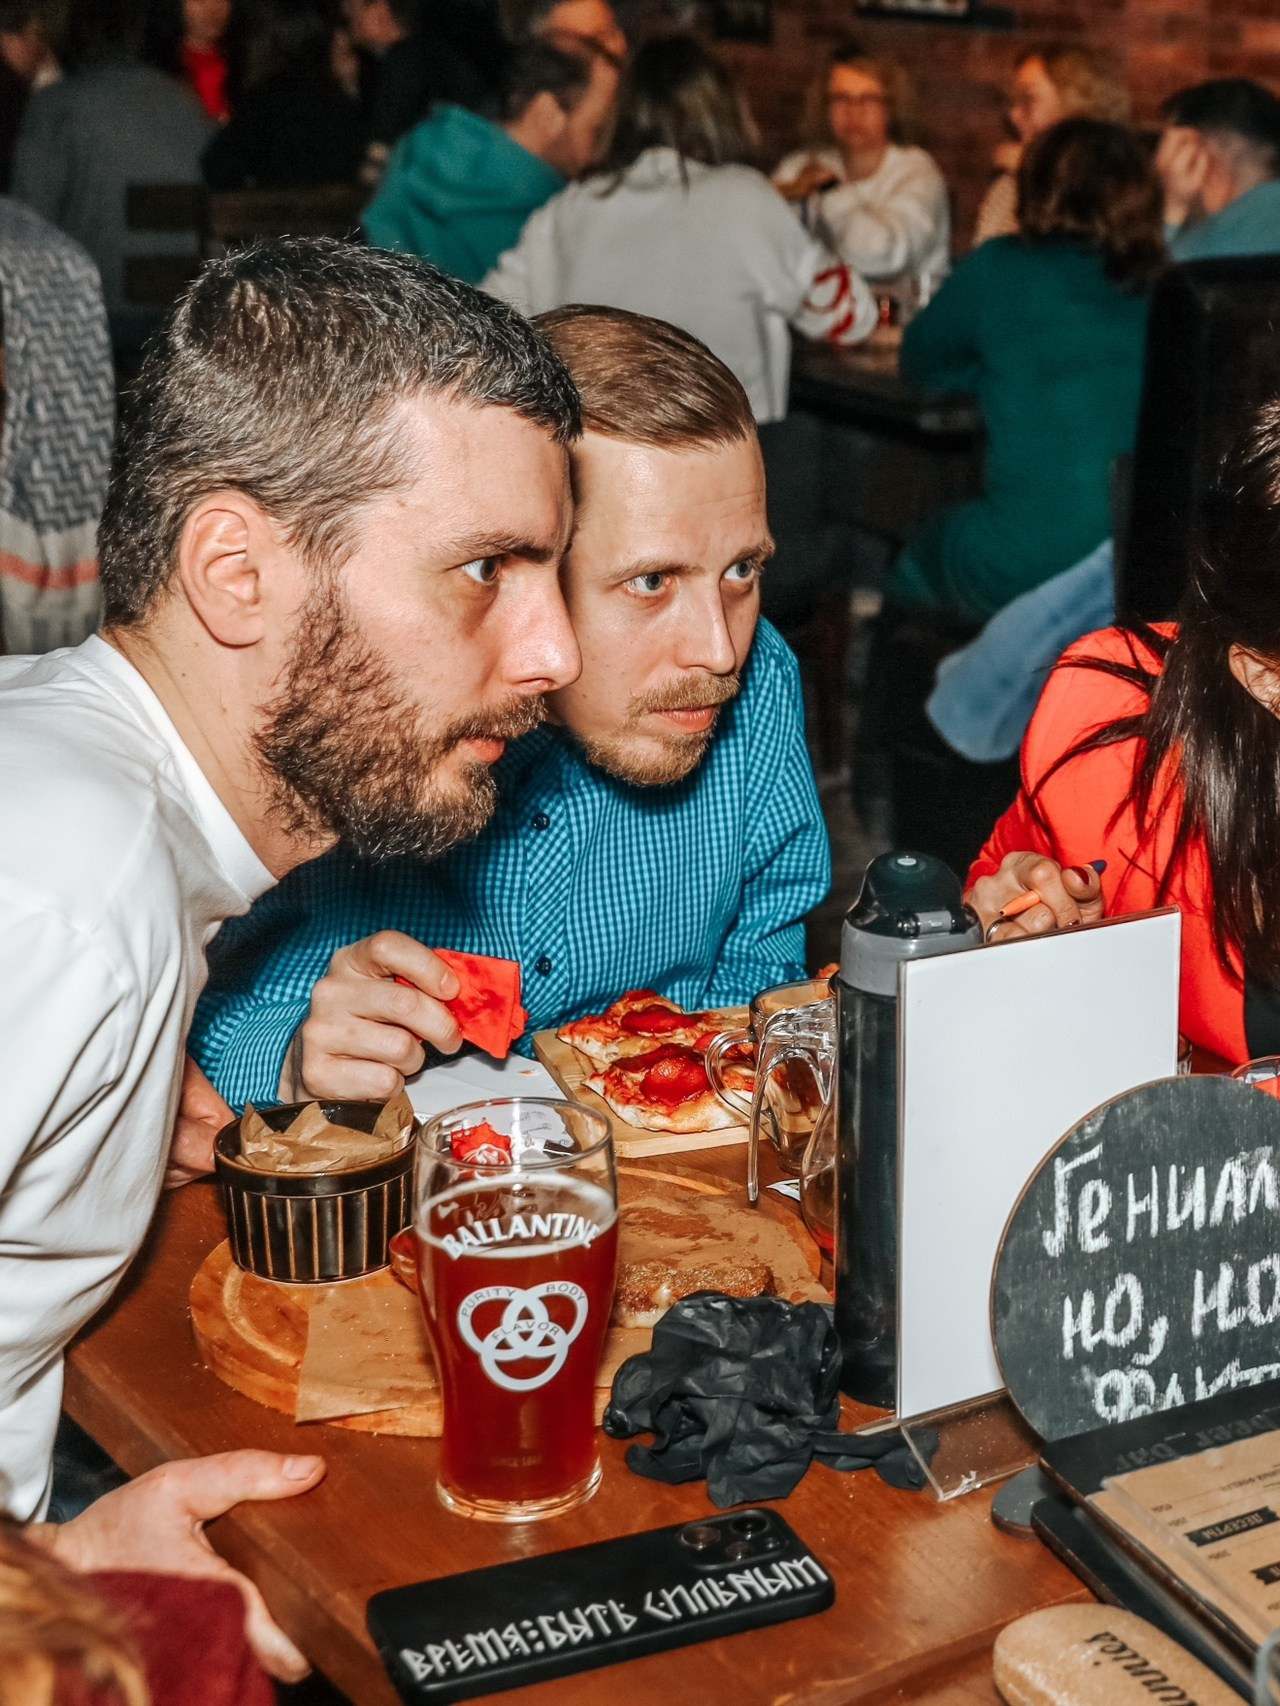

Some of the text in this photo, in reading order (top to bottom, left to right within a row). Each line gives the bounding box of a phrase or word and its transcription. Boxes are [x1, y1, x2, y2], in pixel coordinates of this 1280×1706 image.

[441, 1212, 600, 1261] BALLANTINE
[461, 1288, 516, 1317] PURITY
[546, 1283, 586, 1301] BODY
[491, 1321, 560, 1341] FLAVOR
[1200, 1512, 1263, 1539] ДЕСЕРТЫ
